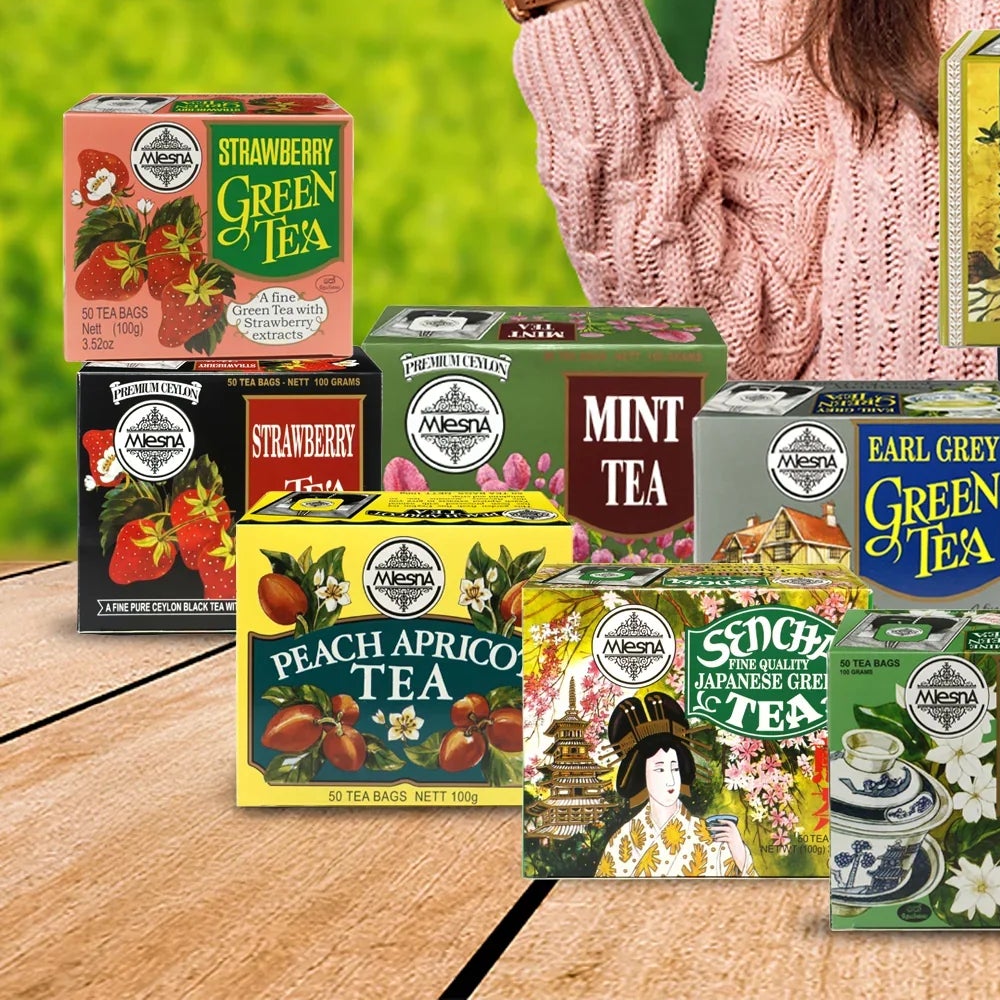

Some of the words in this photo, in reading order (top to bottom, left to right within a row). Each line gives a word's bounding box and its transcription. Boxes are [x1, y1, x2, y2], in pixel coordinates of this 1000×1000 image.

[219, 138, 333, 166] STRAWBERRY
[217, 170, 336, 251] GREEN
[254, 216, 332, 264] TEA
[260, 293, 268, 302] A
[272, 292, 296, 302] fine
[82, 308, 94, 319] 50
[96, 308, 117, 319] TEA
[119, 306, 148, 318] BAGS
[232, 306, 268, 315] Green
[272, 306, 292, 315] Tea
[296, 304, 323, 314] with
[82, 323, 102, 334] Nett
[112, 322, 144, 336] (100g)
[244, 318, 313, 330] Strawberry
[82, 338, 114, 350] 3.52oz
[252, 330, 303, 340] extracts
[405, 356, 461, 376] PREMIUM
[462, 356, 508, 376] CEYLON
[114, 383, 159, 400] PREMIUM
[160, 382, 199, 399] CEYLON
[228, 378, 237, 386] 50
[239, 378, 256, 386] TEA
[258, 378, 280, 386] BAGS
[287, 378, 310, 386] NETT
[314, 378, 328, 386] 100
[330, 378, 360, 386] GRAMS
[583, 396, 683, 442] MINT
[252, 424, 355, 458] STRAWBERRY
[868, 436, 930, 462] EARL
[936, 436, 1000, 462] GREY
[601, 460, 668, 506] TEA
[865, 471, 1000, 563] GREEN
[906, 522, 995, 579] TEA
[270, 631, 382, 680] PEACH
[840, 659, 850, 668] 50
[853, 659, 871, 668] TEA
[874, 659, 900, 668] BAGS
[729, 659, 756, 670] FINE
[760, 659, 809, 672] QUALITY
[350, 663, 453, 702] TEA
[695, 673, 782, 690] JAPANESE
[726, 693, 824, 731] TEA
[329, 792, 342, 802] 50
[346, 792, 370, 802] TEA
[373, 792, 407, 802] BAGS
[415, 792, 446, 802] NETT
[451, 792, 478, 804] 100g
